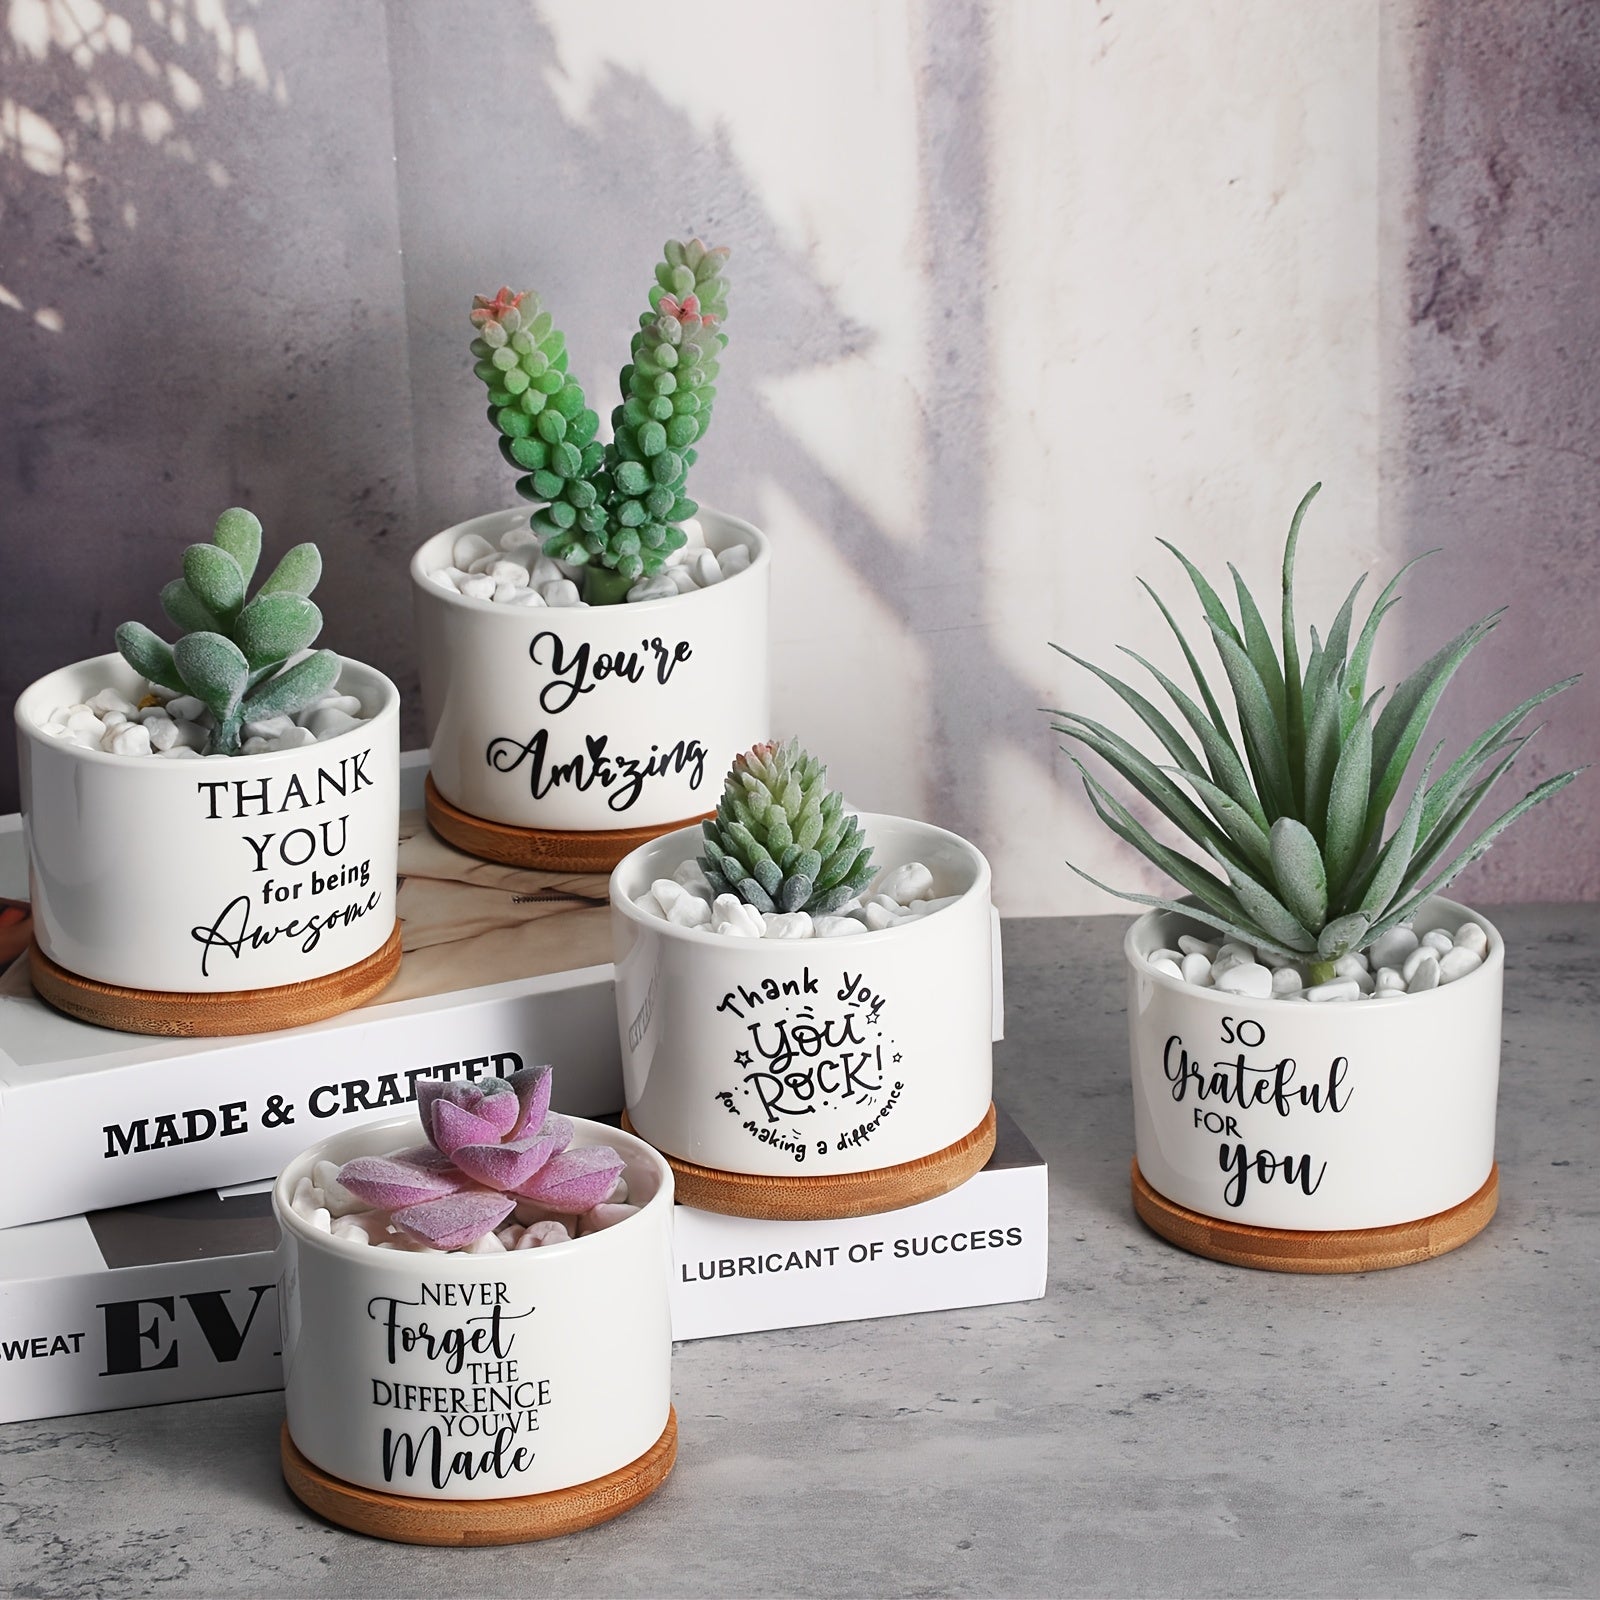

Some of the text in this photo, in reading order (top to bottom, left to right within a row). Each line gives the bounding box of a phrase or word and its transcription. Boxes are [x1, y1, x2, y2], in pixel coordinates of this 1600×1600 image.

[529, 631, 693, 714] You're
[198, 748, 374, 819] THANK
[486, 729, 708, 812] Amazing
[242, 815, 349, 872] YOU
[262, 859, 371, 904] for being
[191, 891, 382, 977] Awesome
[716, 967, 819, 1019] Thank
[1220, 1016, 1266, 1048] SO
[743, 1045, 883, 1123] ROCK!
[1163, 1035, 1354, 1117] Grateful
[102, 1101, 248, 1158] MADE
[261, 1094, 295, 1128] &
[715, 1081, 904, 1162] for making a difference
[1193, 1108, 1243, 1139] FOR
[1219, 1143, 1328, 1208] you
[682, 1227, 1023, 1282] LUBRICANT OF SUCCESS
[420, 1282, 511, 1306] NEVER
[367, 1296, 536, 1374] Forget
[371, 1379, 552, 1413] DIFFERENCE
[466, 1360, 519, 1385] THE
[440, 1409, 540, 1437] YOU'VE
[382, 1425, 535, 1490] Made
